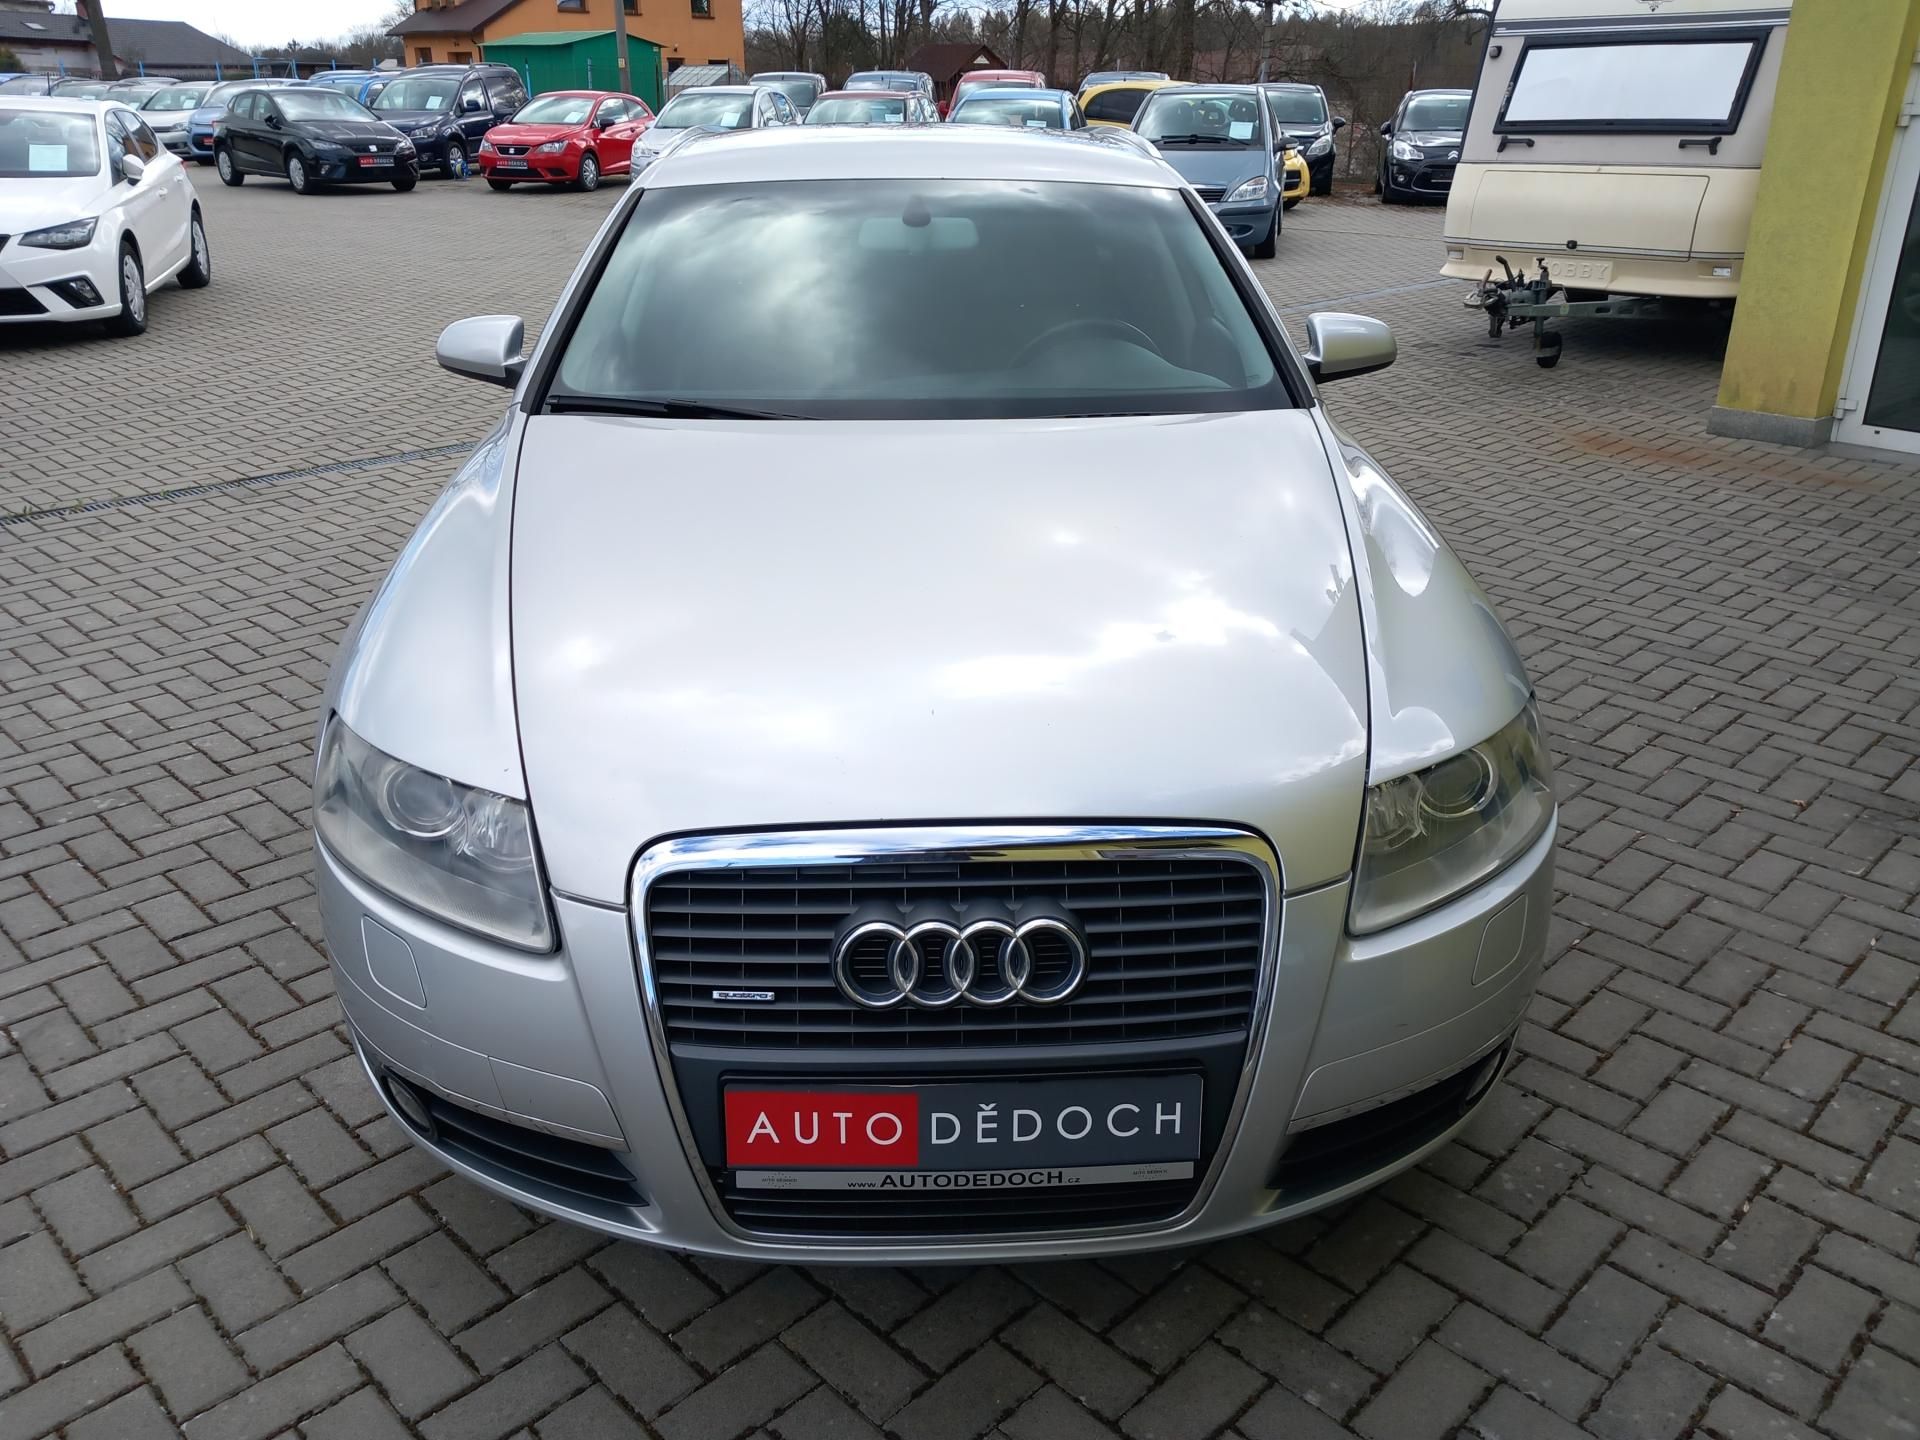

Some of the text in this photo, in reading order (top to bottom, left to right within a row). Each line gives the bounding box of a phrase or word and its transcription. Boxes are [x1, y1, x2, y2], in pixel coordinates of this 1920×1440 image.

[746, 1102, 1182, 1147] AUTO DĚDOCH
[847, 1170, 1082, 1189] www.AUTODEDOCH.cz
